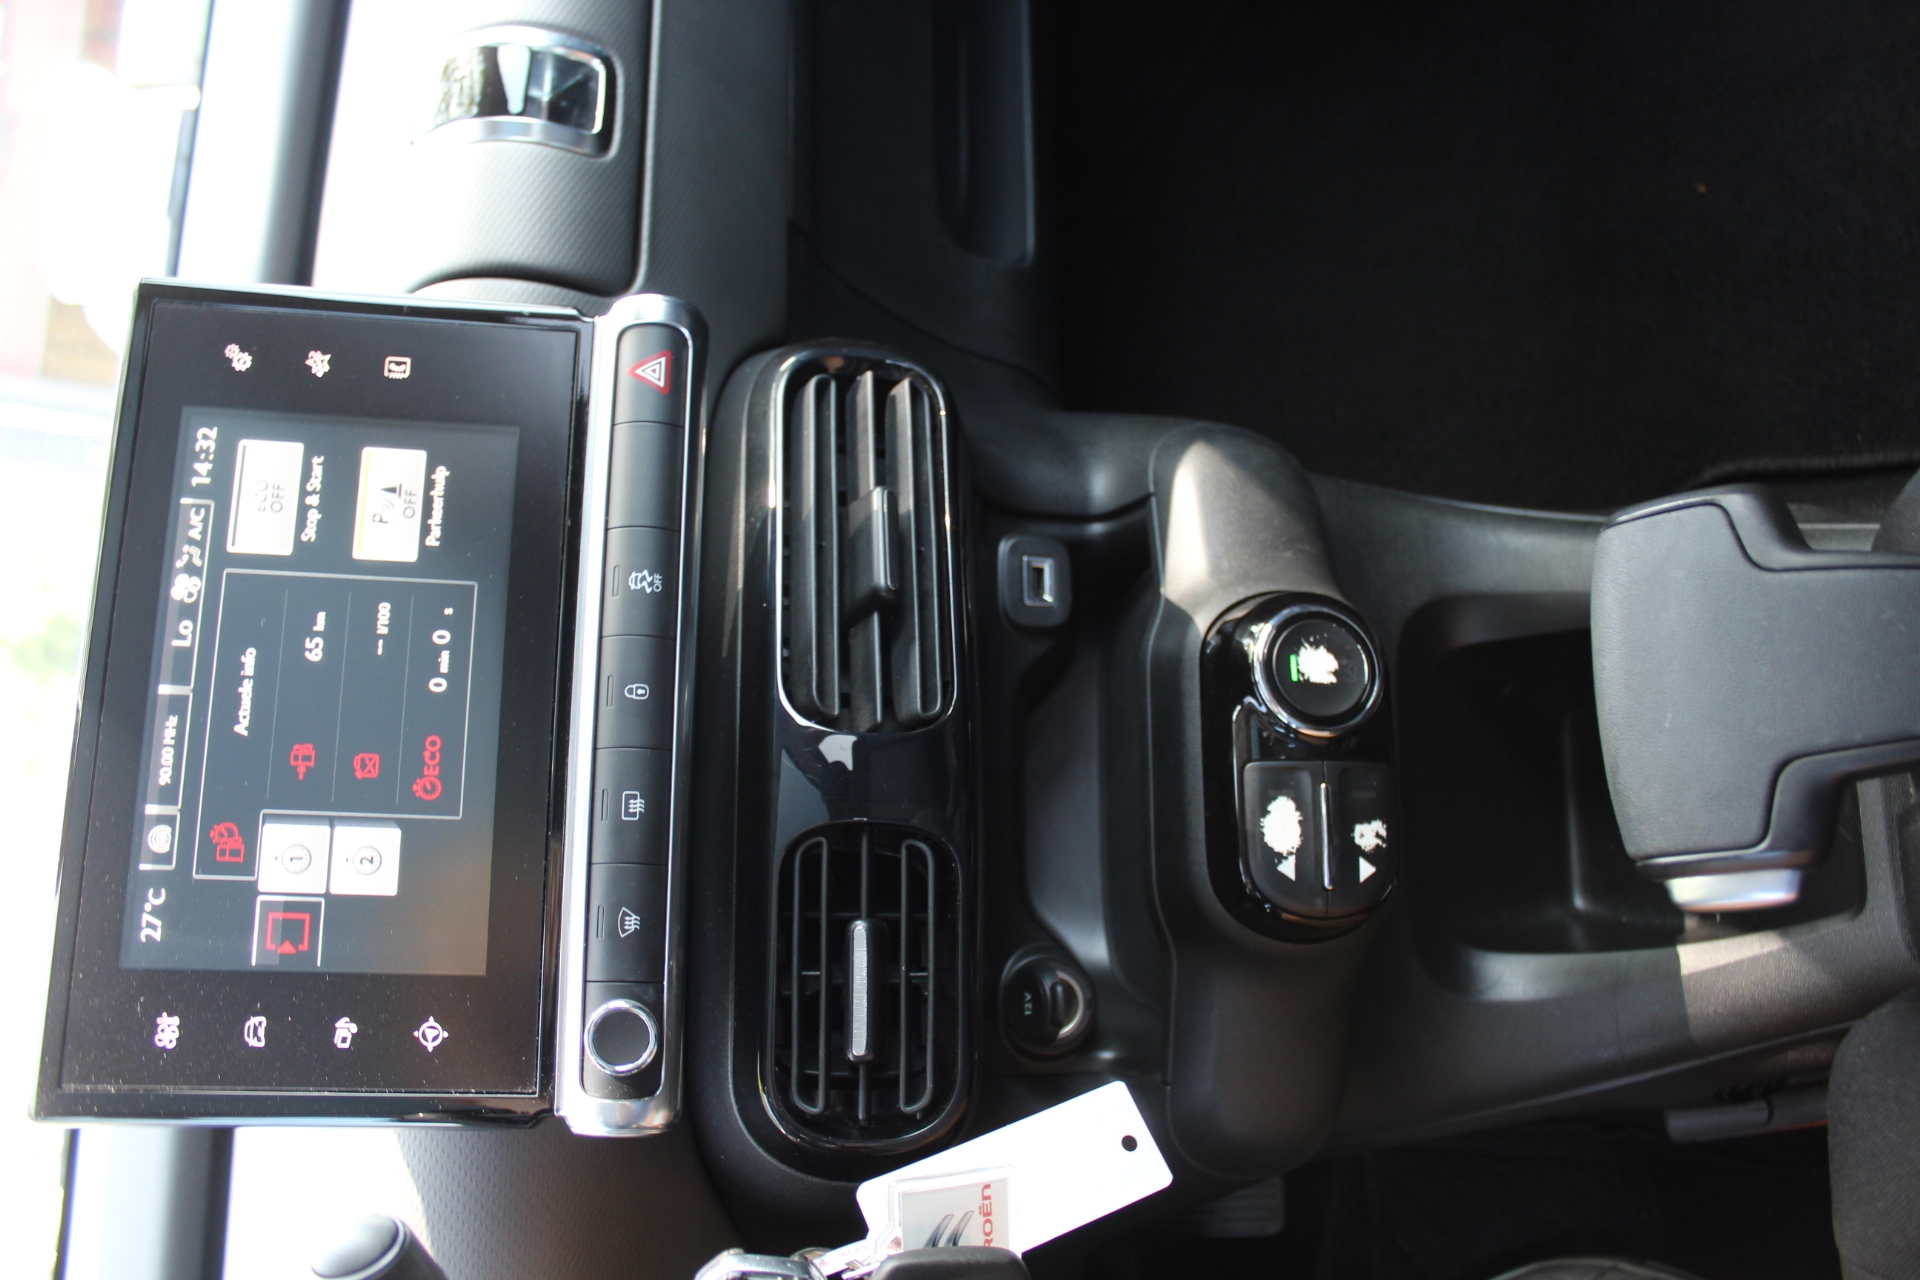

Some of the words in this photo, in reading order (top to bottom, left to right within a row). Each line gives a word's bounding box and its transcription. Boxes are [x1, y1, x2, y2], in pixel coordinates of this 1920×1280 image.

[192, 426, 218, 487] 14:32
[305, 455, 325, 491] Start
[270, 482, 286, 514] OFF
[403, 487, 418, 520] OFF
[425, 465, 451, 547] Parkeerhulp
[188, 507, 206, 541] A/C
[300, 508, 323, 543] Stop
[653, 572, 663, 592] OFF
[172, 620, 194, 648] Lo
[313, 611, 327, 632] km
[241, 647, 258, 680] info
[305, 636, 325, 662] 65
[438, 650, 451, 673] min
[233, 680, 257, 737] Actuele
[163, 714, 179, 745] MHz
[159, 746, 175, 786] 90.00
[424, 735, 442, 777] ECO
[360, 855, 374, 866] 2
[140, 888, 168, 943] 27°C
[978, 1184, 993, 1247] ROËN
